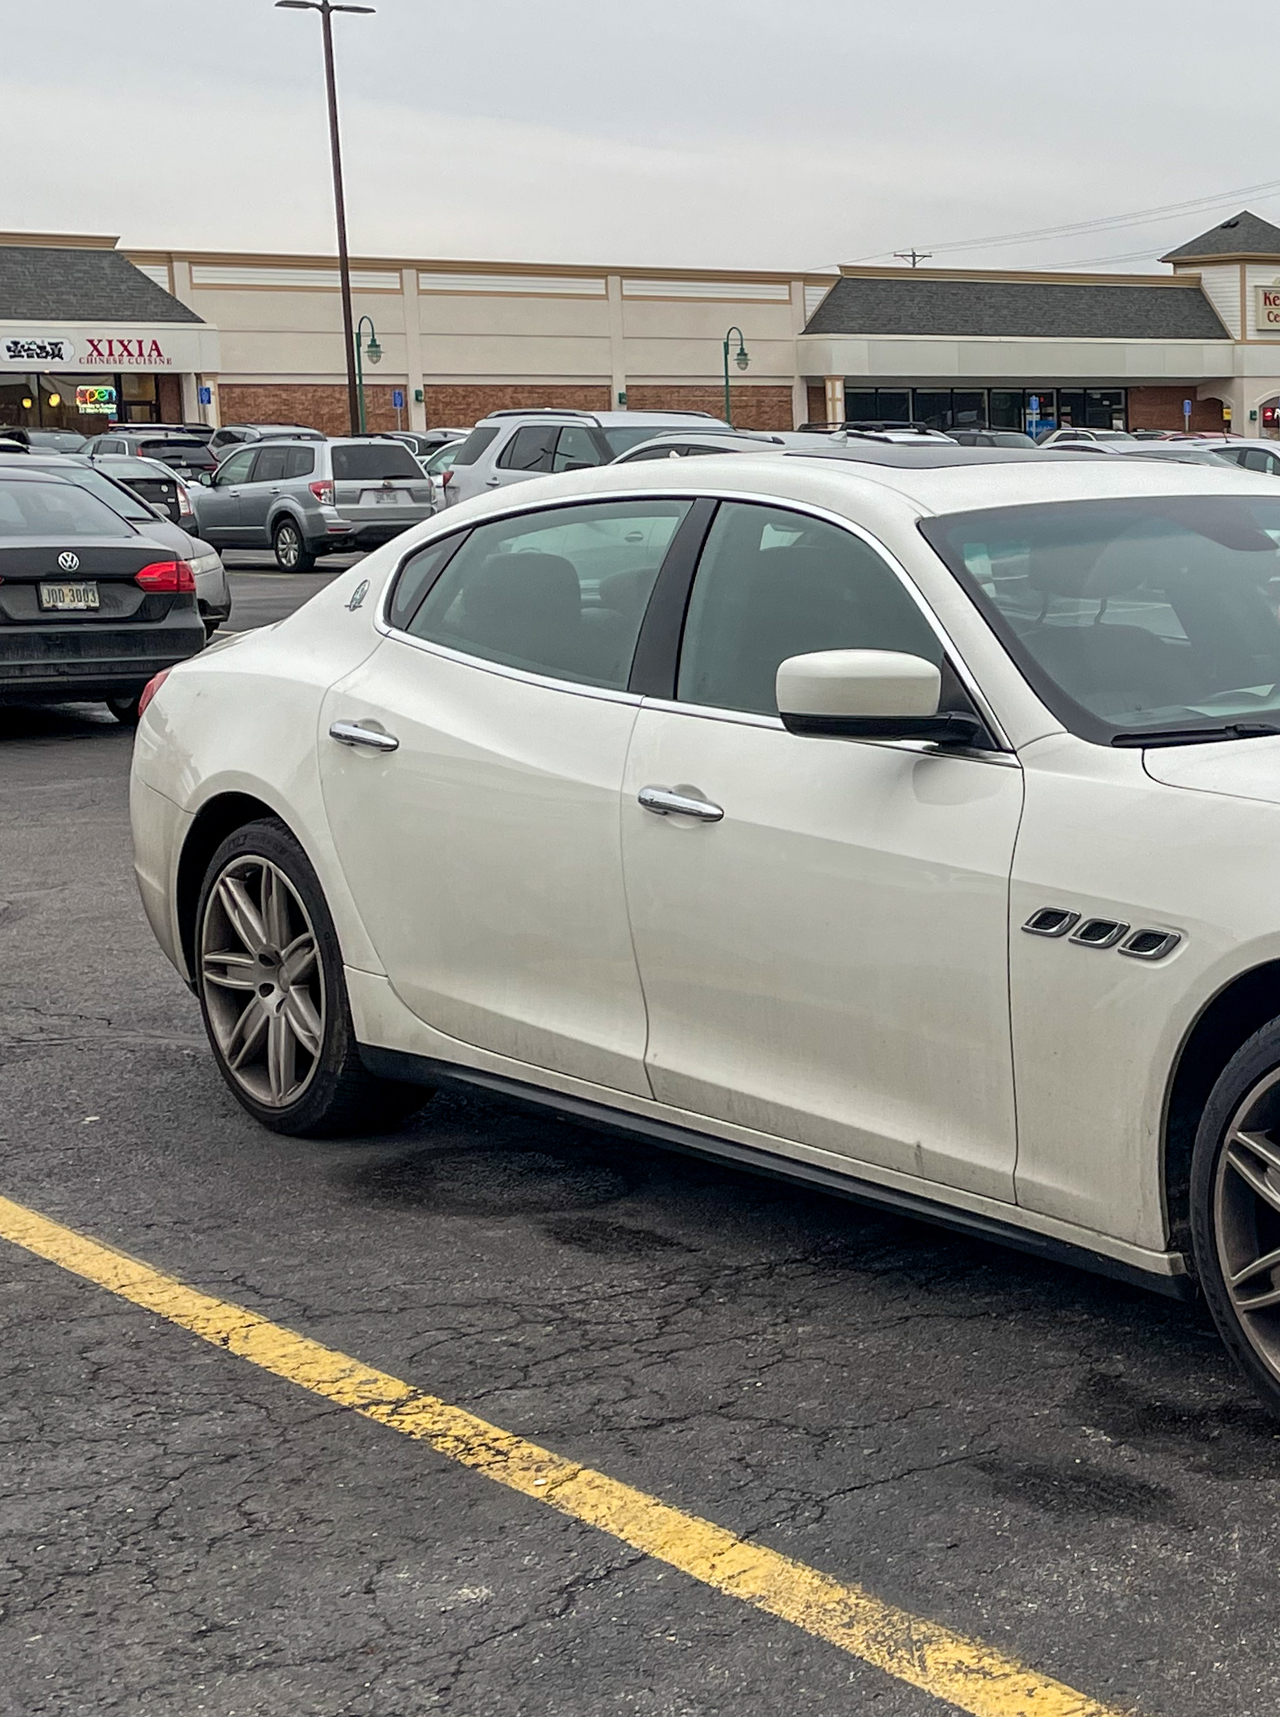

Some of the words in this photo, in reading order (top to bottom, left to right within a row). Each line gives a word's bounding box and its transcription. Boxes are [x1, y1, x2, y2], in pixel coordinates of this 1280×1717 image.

[86, 338, 164, 357] XIXIA
[78, 356, 124, 365] CHINESE
[128, 356, 173, 366] CUISINE
[68, 588, 96, 603] 3003
